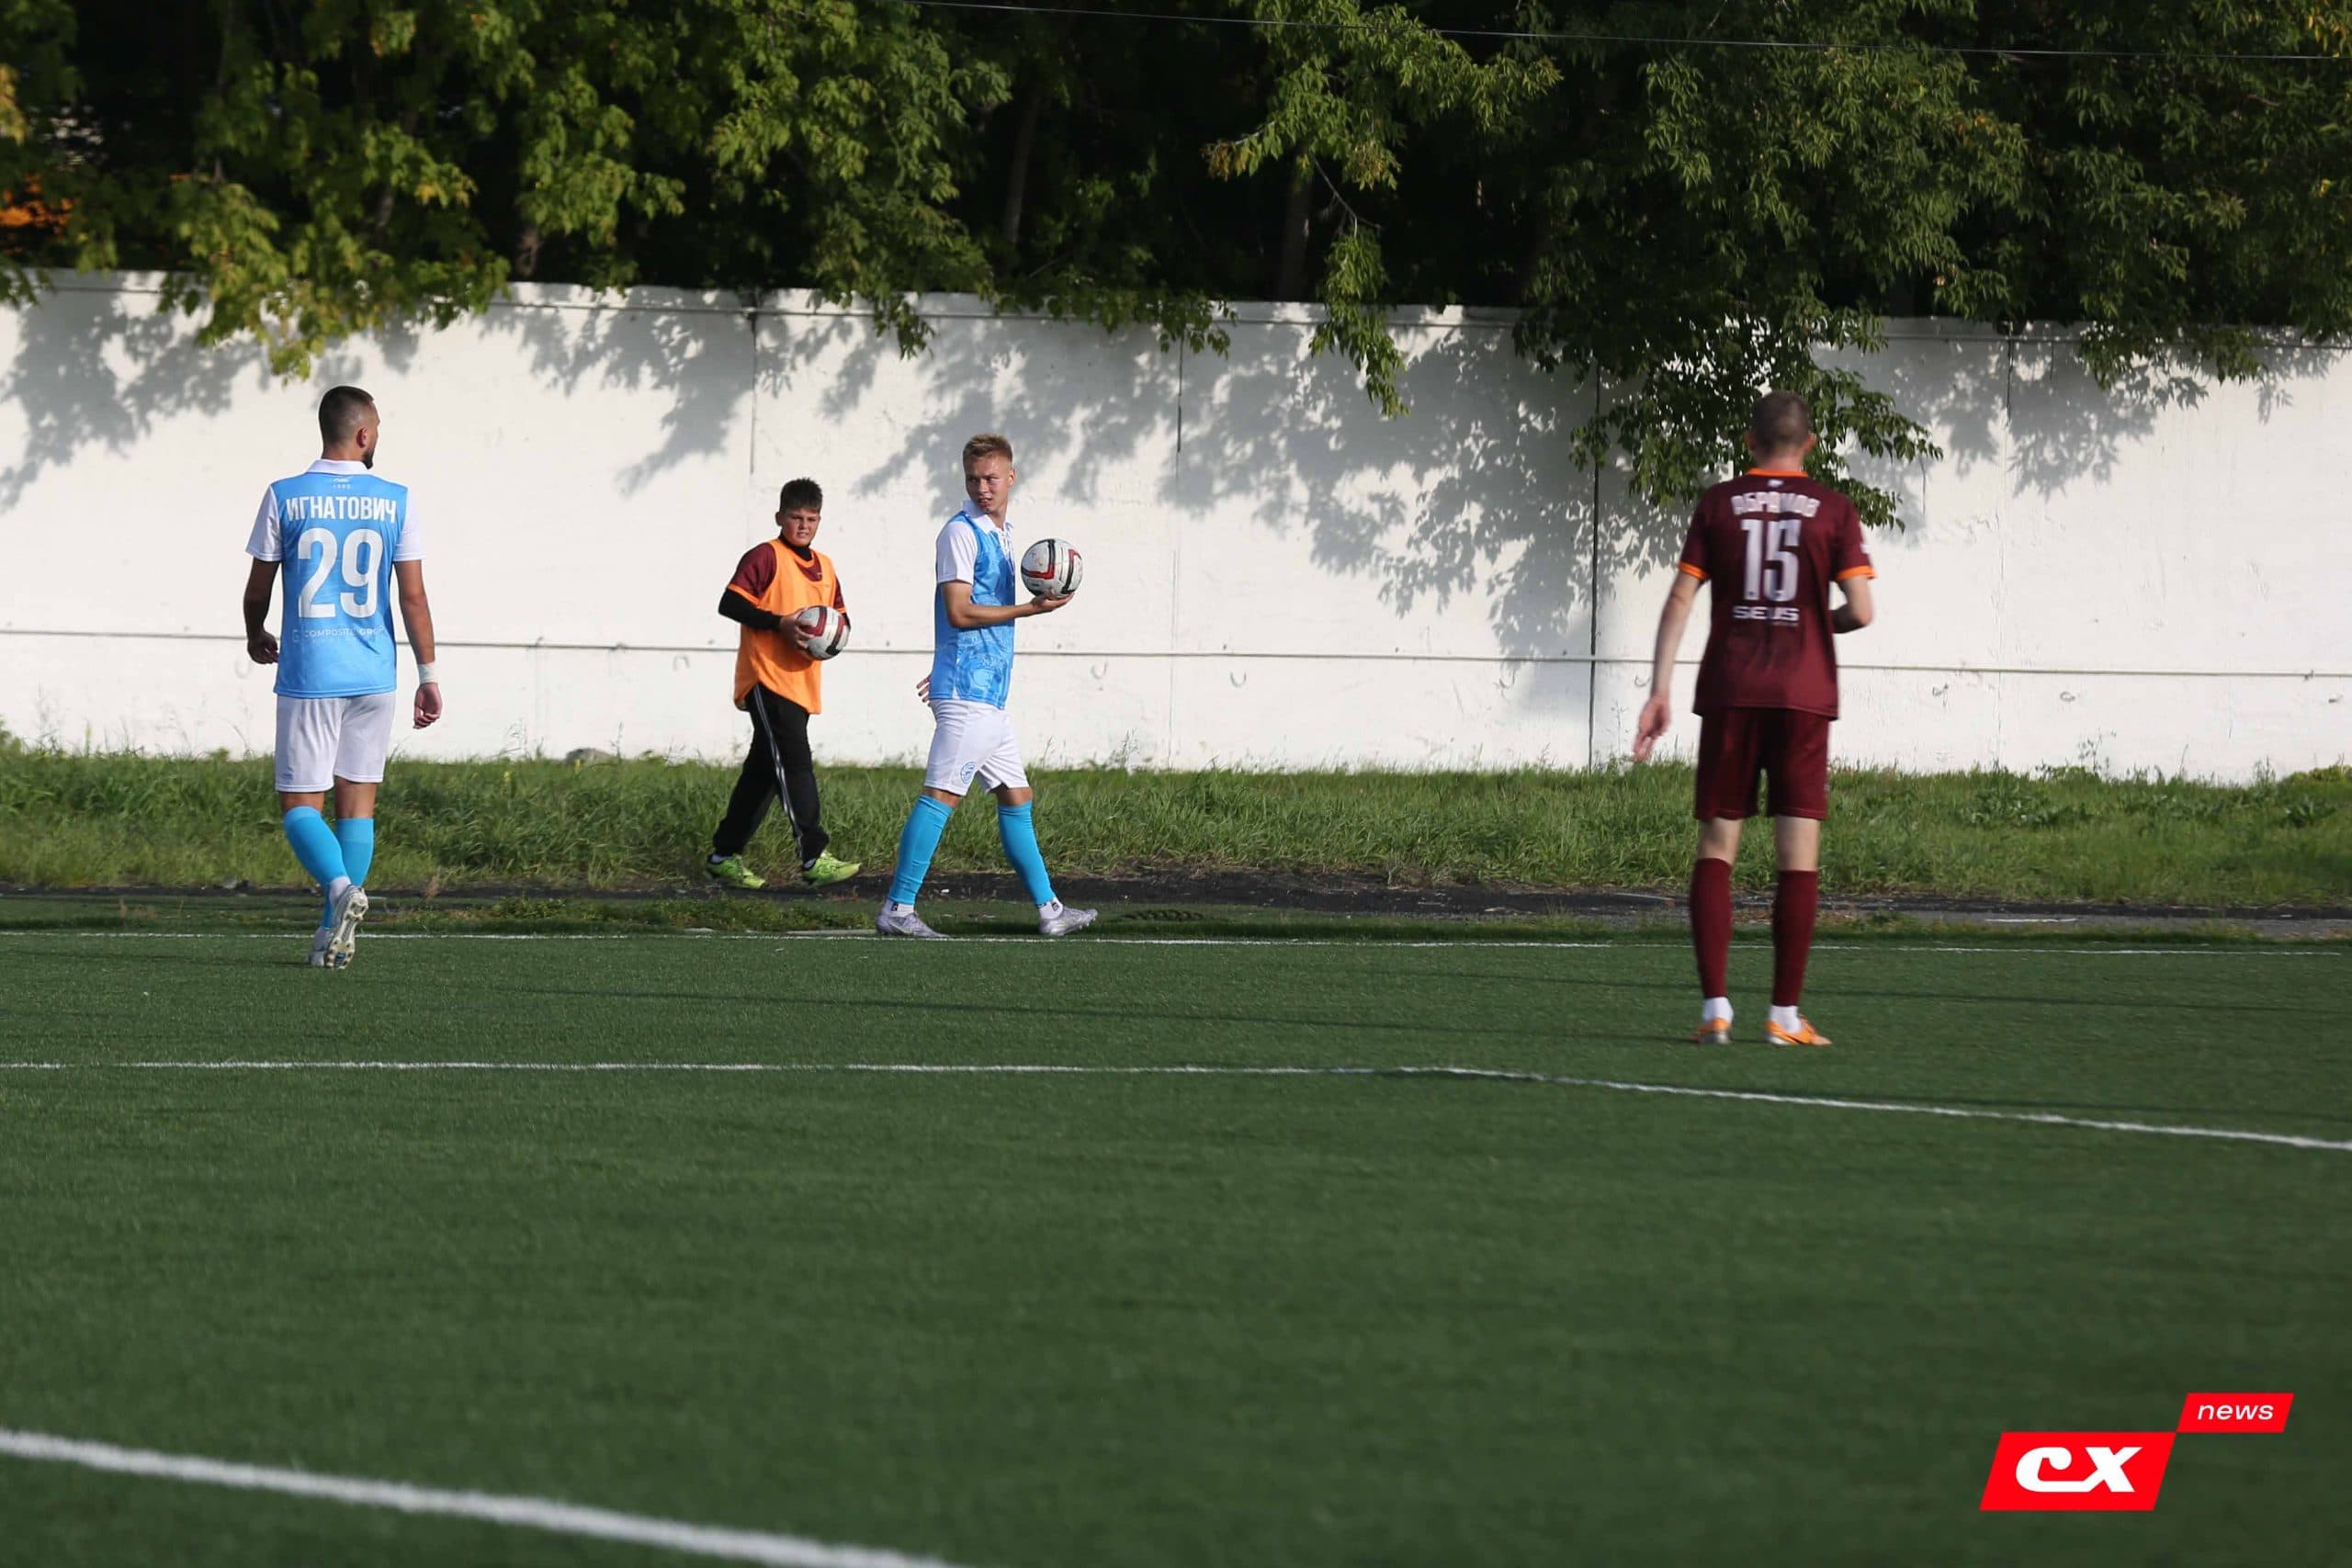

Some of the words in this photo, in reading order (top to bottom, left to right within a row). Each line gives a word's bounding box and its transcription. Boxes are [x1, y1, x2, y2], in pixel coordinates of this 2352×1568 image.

[286, 495, 397, 524] ИГНАТОВИЧ
[298, 527, 384, 618] 29
[1740, 519, 1802, 602] 15
